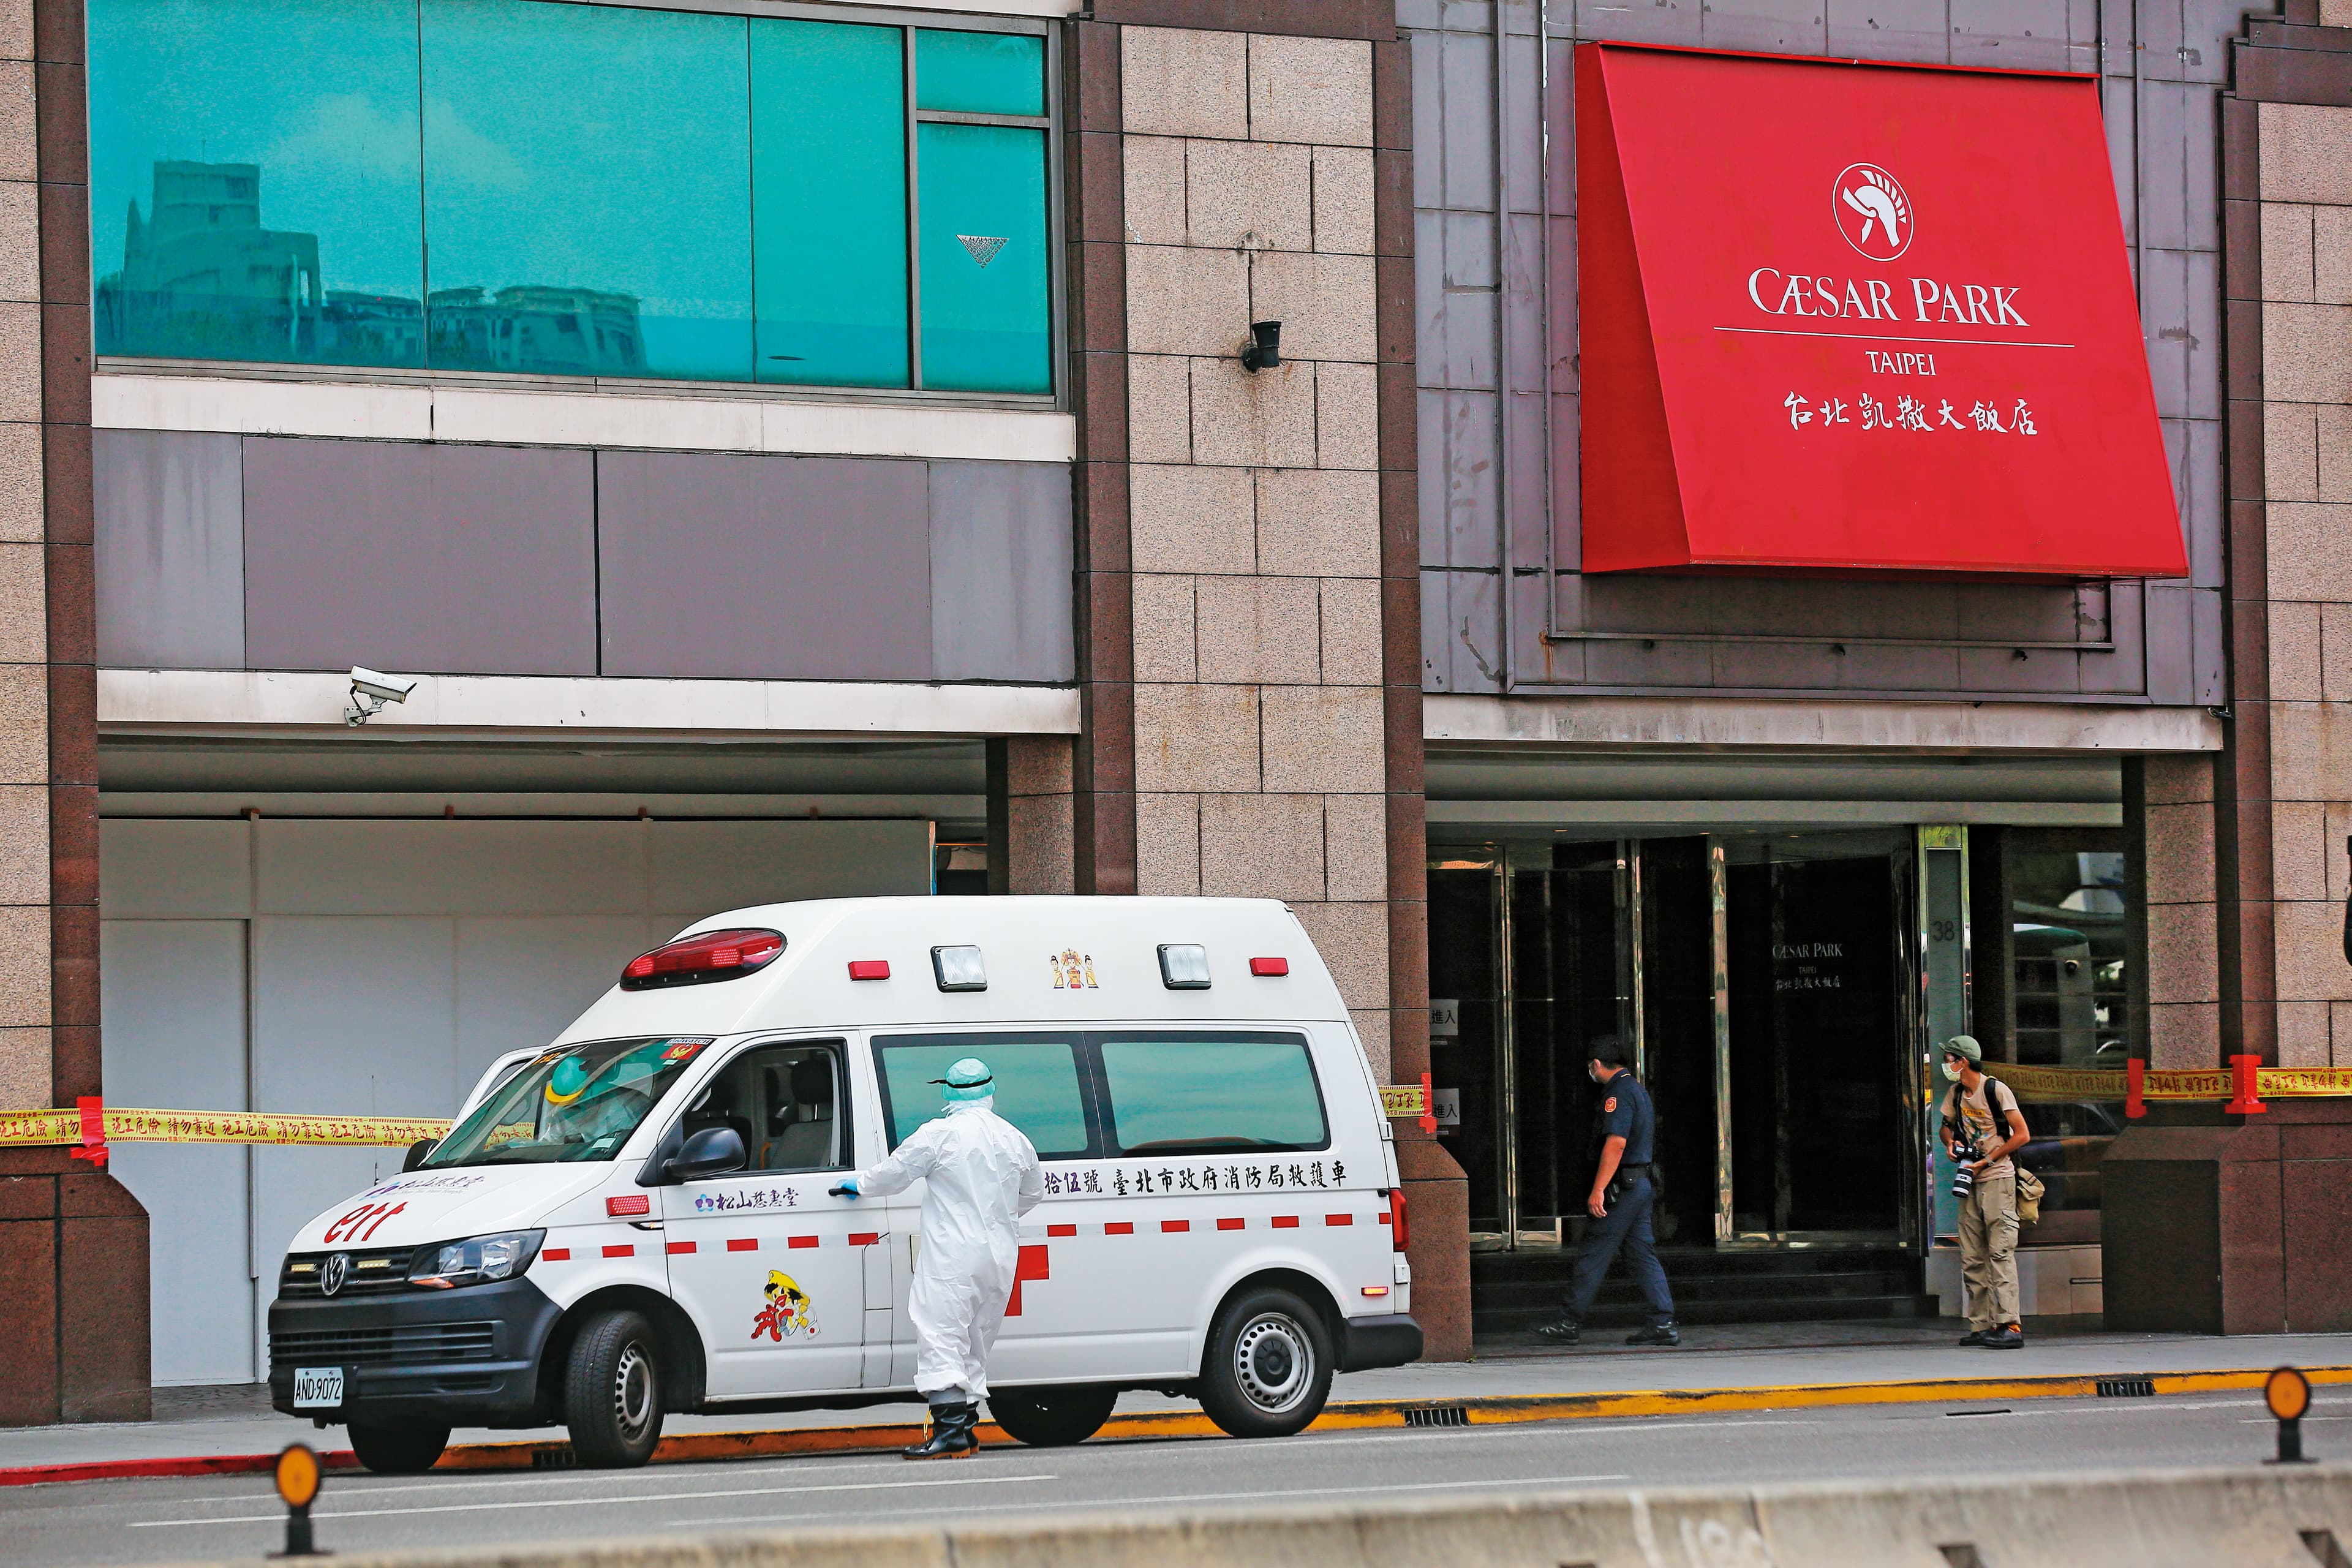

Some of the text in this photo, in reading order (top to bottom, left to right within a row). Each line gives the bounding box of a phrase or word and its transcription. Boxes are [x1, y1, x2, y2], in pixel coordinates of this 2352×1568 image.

[1747, 267, 2030, 326] CÆSAR PARK
[1865, 351, 1936, 376] TAIPEI
[1784, 390, 2038, 435] 台北凱撒大飯店
[1933, 921, 1954, 941] 38
[1814, 943, 1843, 957] PARK
[1429, 1009, 1456, 1024] 進入
[1113, 1161, 1348, 1196] 臺北市政府消防局救護車
